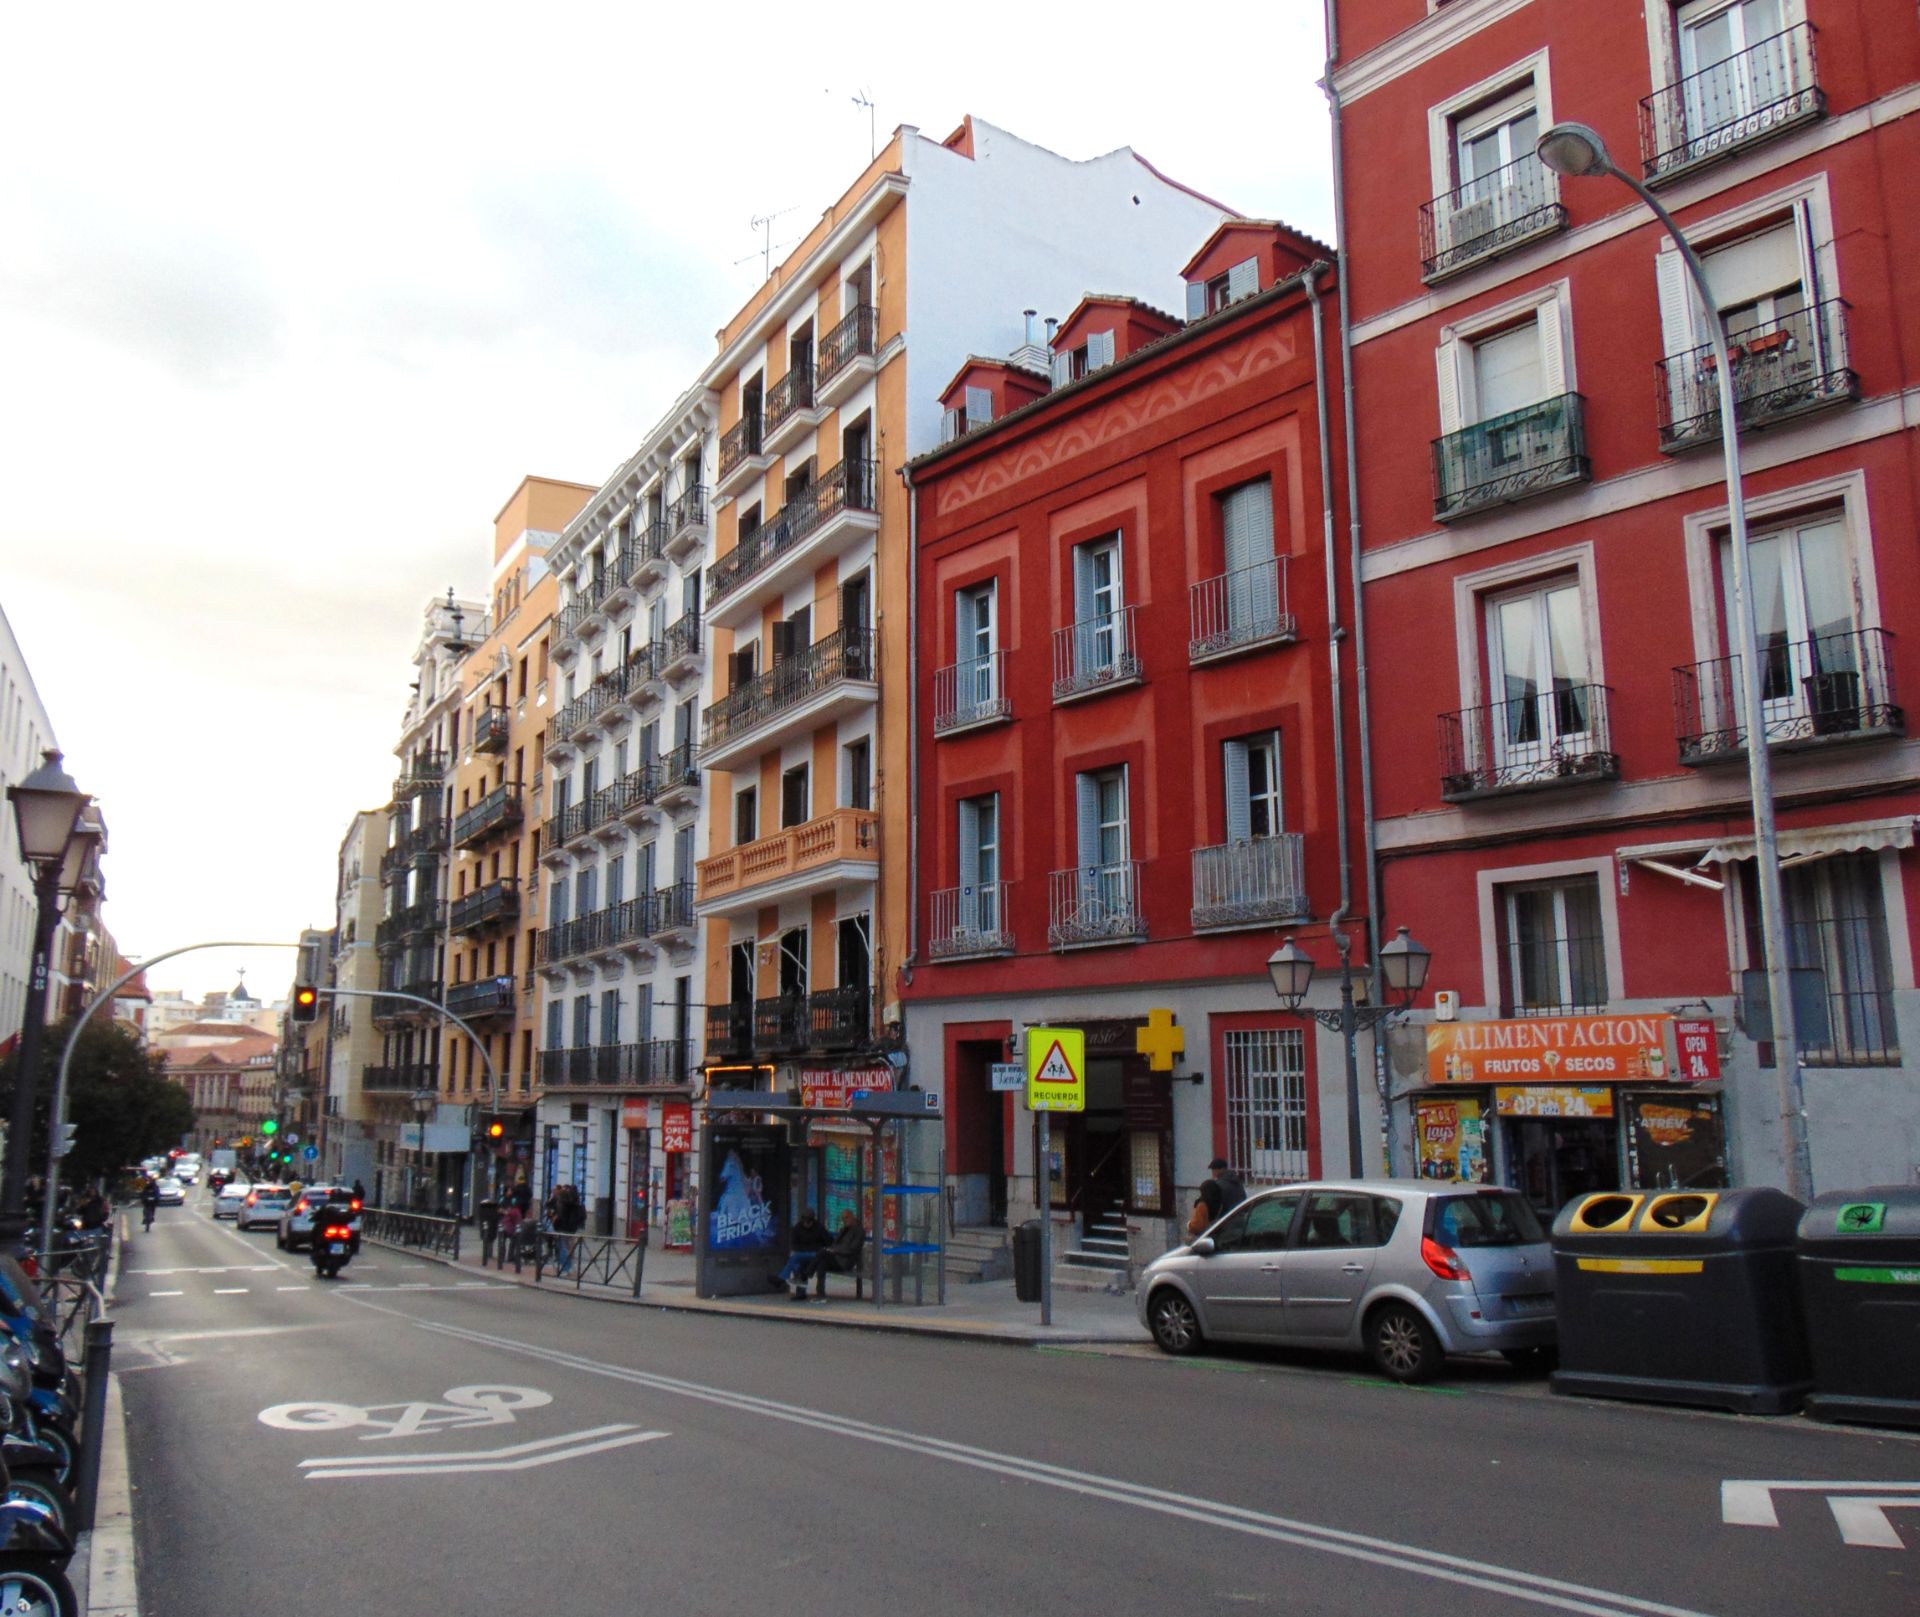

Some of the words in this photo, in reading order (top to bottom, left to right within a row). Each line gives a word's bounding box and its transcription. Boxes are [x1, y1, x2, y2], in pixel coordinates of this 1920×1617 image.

[1453, 1019, 1658, 1050] ALIMENTACION
[1685, 1036, 1708, 1052] OPEN
[1484, 1059, 1540, 1073] FRUTOS
[1564, 1056, 1616, 1071] SECOS
[802, 1071, 831, 1087] SYLHET
[1034, 1091, 1079, 1101] RECUERDE
[665, 1126, 689, 1135] OPEN
[664, 1136, 690, 1150] 24h
[717, 1200, 772, 1228] BLACK
[717, 1215, 772, 1243] FRIDAY
